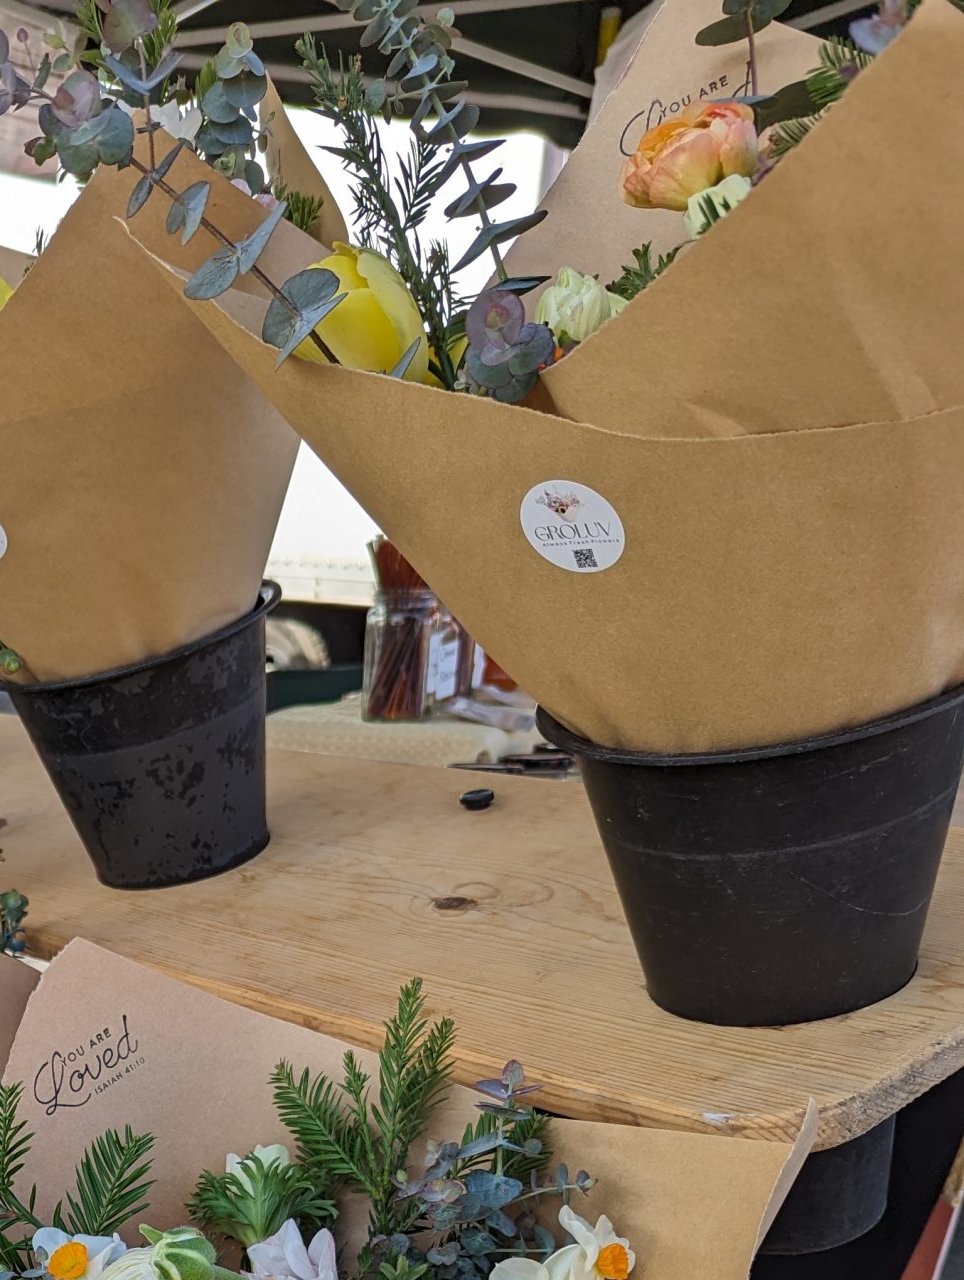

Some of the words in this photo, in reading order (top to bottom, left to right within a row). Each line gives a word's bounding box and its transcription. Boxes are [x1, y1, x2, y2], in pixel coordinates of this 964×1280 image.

[699, 75, 729, 99] ARE
[534, 521, 611, 542] GROLUV
[34, 1014, 138, 1116] Loved
[60, 1045, 85, 1067] YOU
[89, 1028, 111, 1049] ARE
[94, 1073, 123, 1095] ISAIAH
[125, 1057, 146, 1075] 41:10
